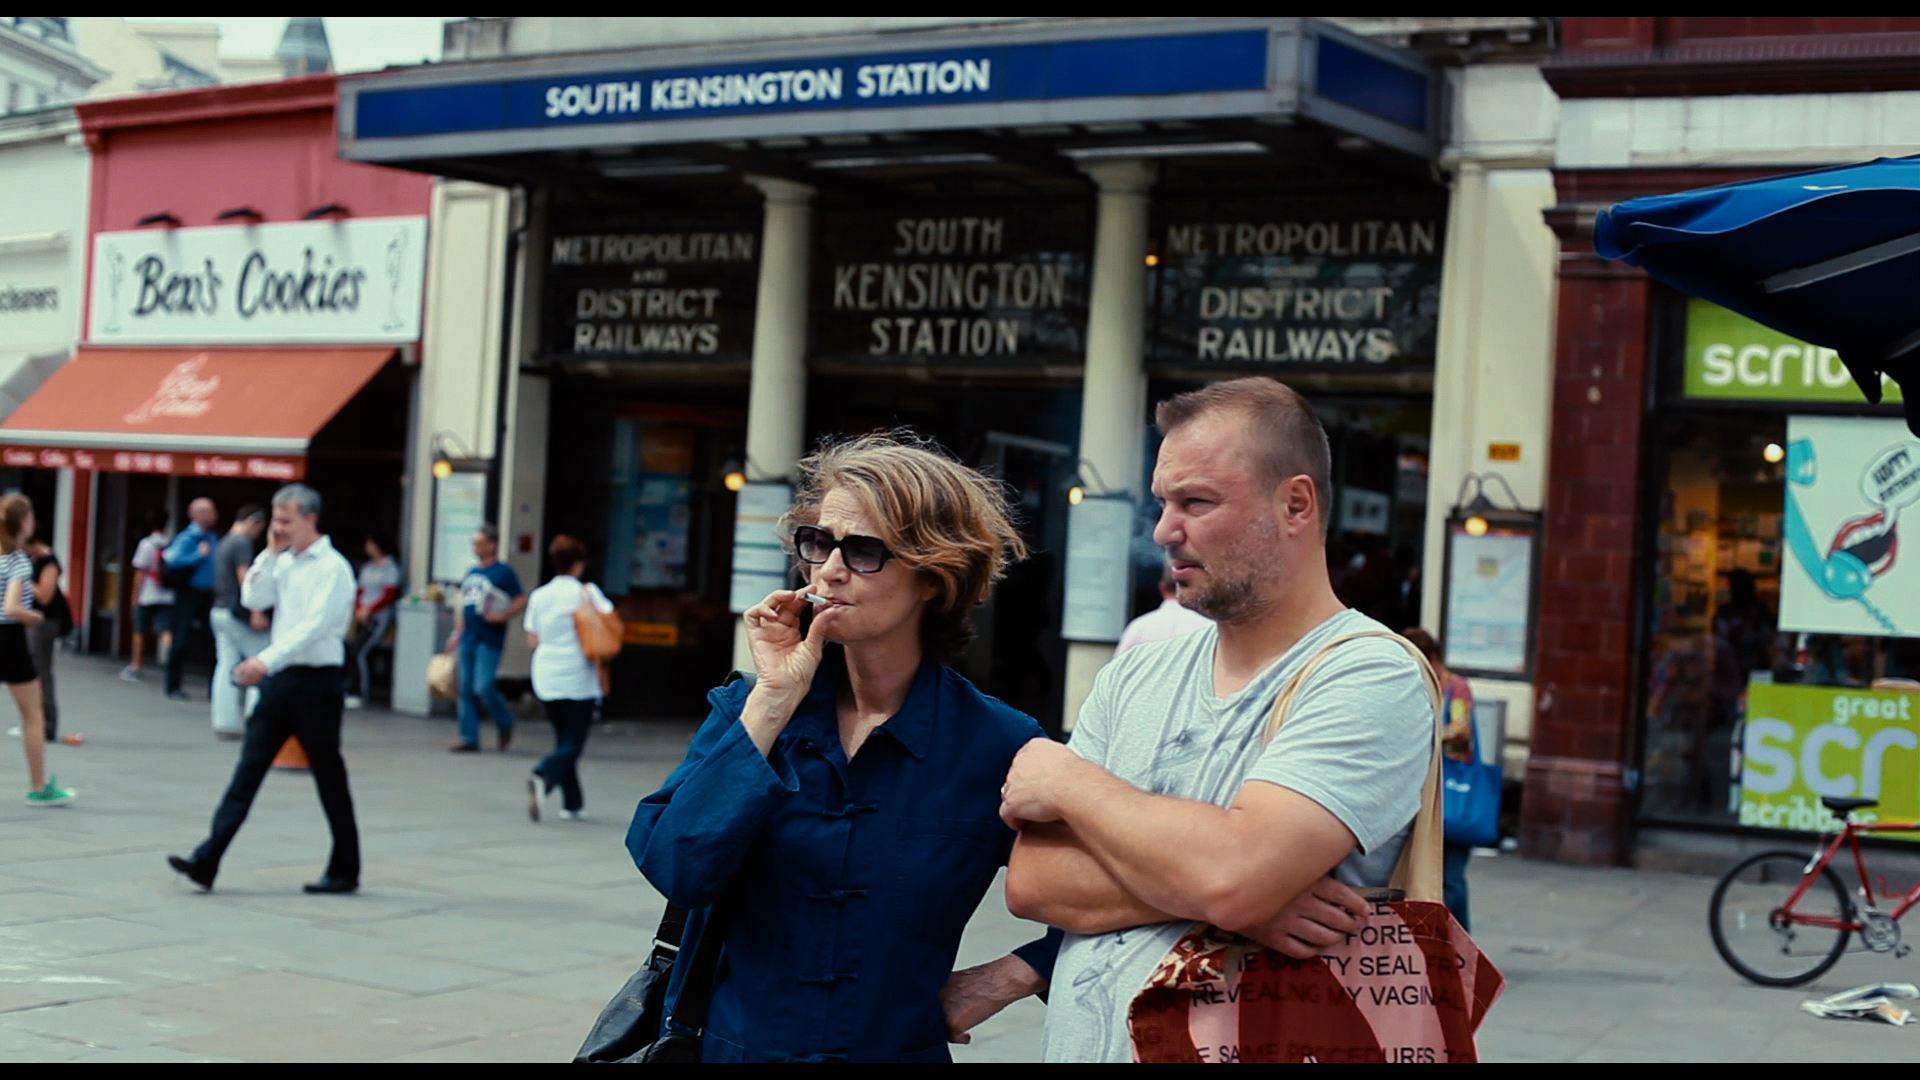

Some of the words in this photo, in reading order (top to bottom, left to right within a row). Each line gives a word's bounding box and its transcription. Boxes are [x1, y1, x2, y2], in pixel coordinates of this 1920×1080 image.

[545, 82, 641, 118] SOUTH
[651, 68, 842, 111] KENSINGTON
[857, 58, 990, 98] STATION
[551, 233, 754, 265] METROPOLITAN
[893, 216, 1004, 257] SOUTH
[1166, 220, 1436, 256] METROPOLITAN
[132, 252, 223, 317] Ben's
[236, 245, 368, 319] Cookies
[832, 262, 1065, 312] KENSINGTON
[576, 288, 721, 319] DISTRICT
[1199, 286, 1393, 320] DISTRICT
[574, 323, 720, 355] RAILWAYS
[869, 317, 1018, 357] STATION
[1197, 327, 1396, 364] RAILWAYS
[1833, 694, 1911, 725] great
[1360, 955, 1421, 976] SEAL
